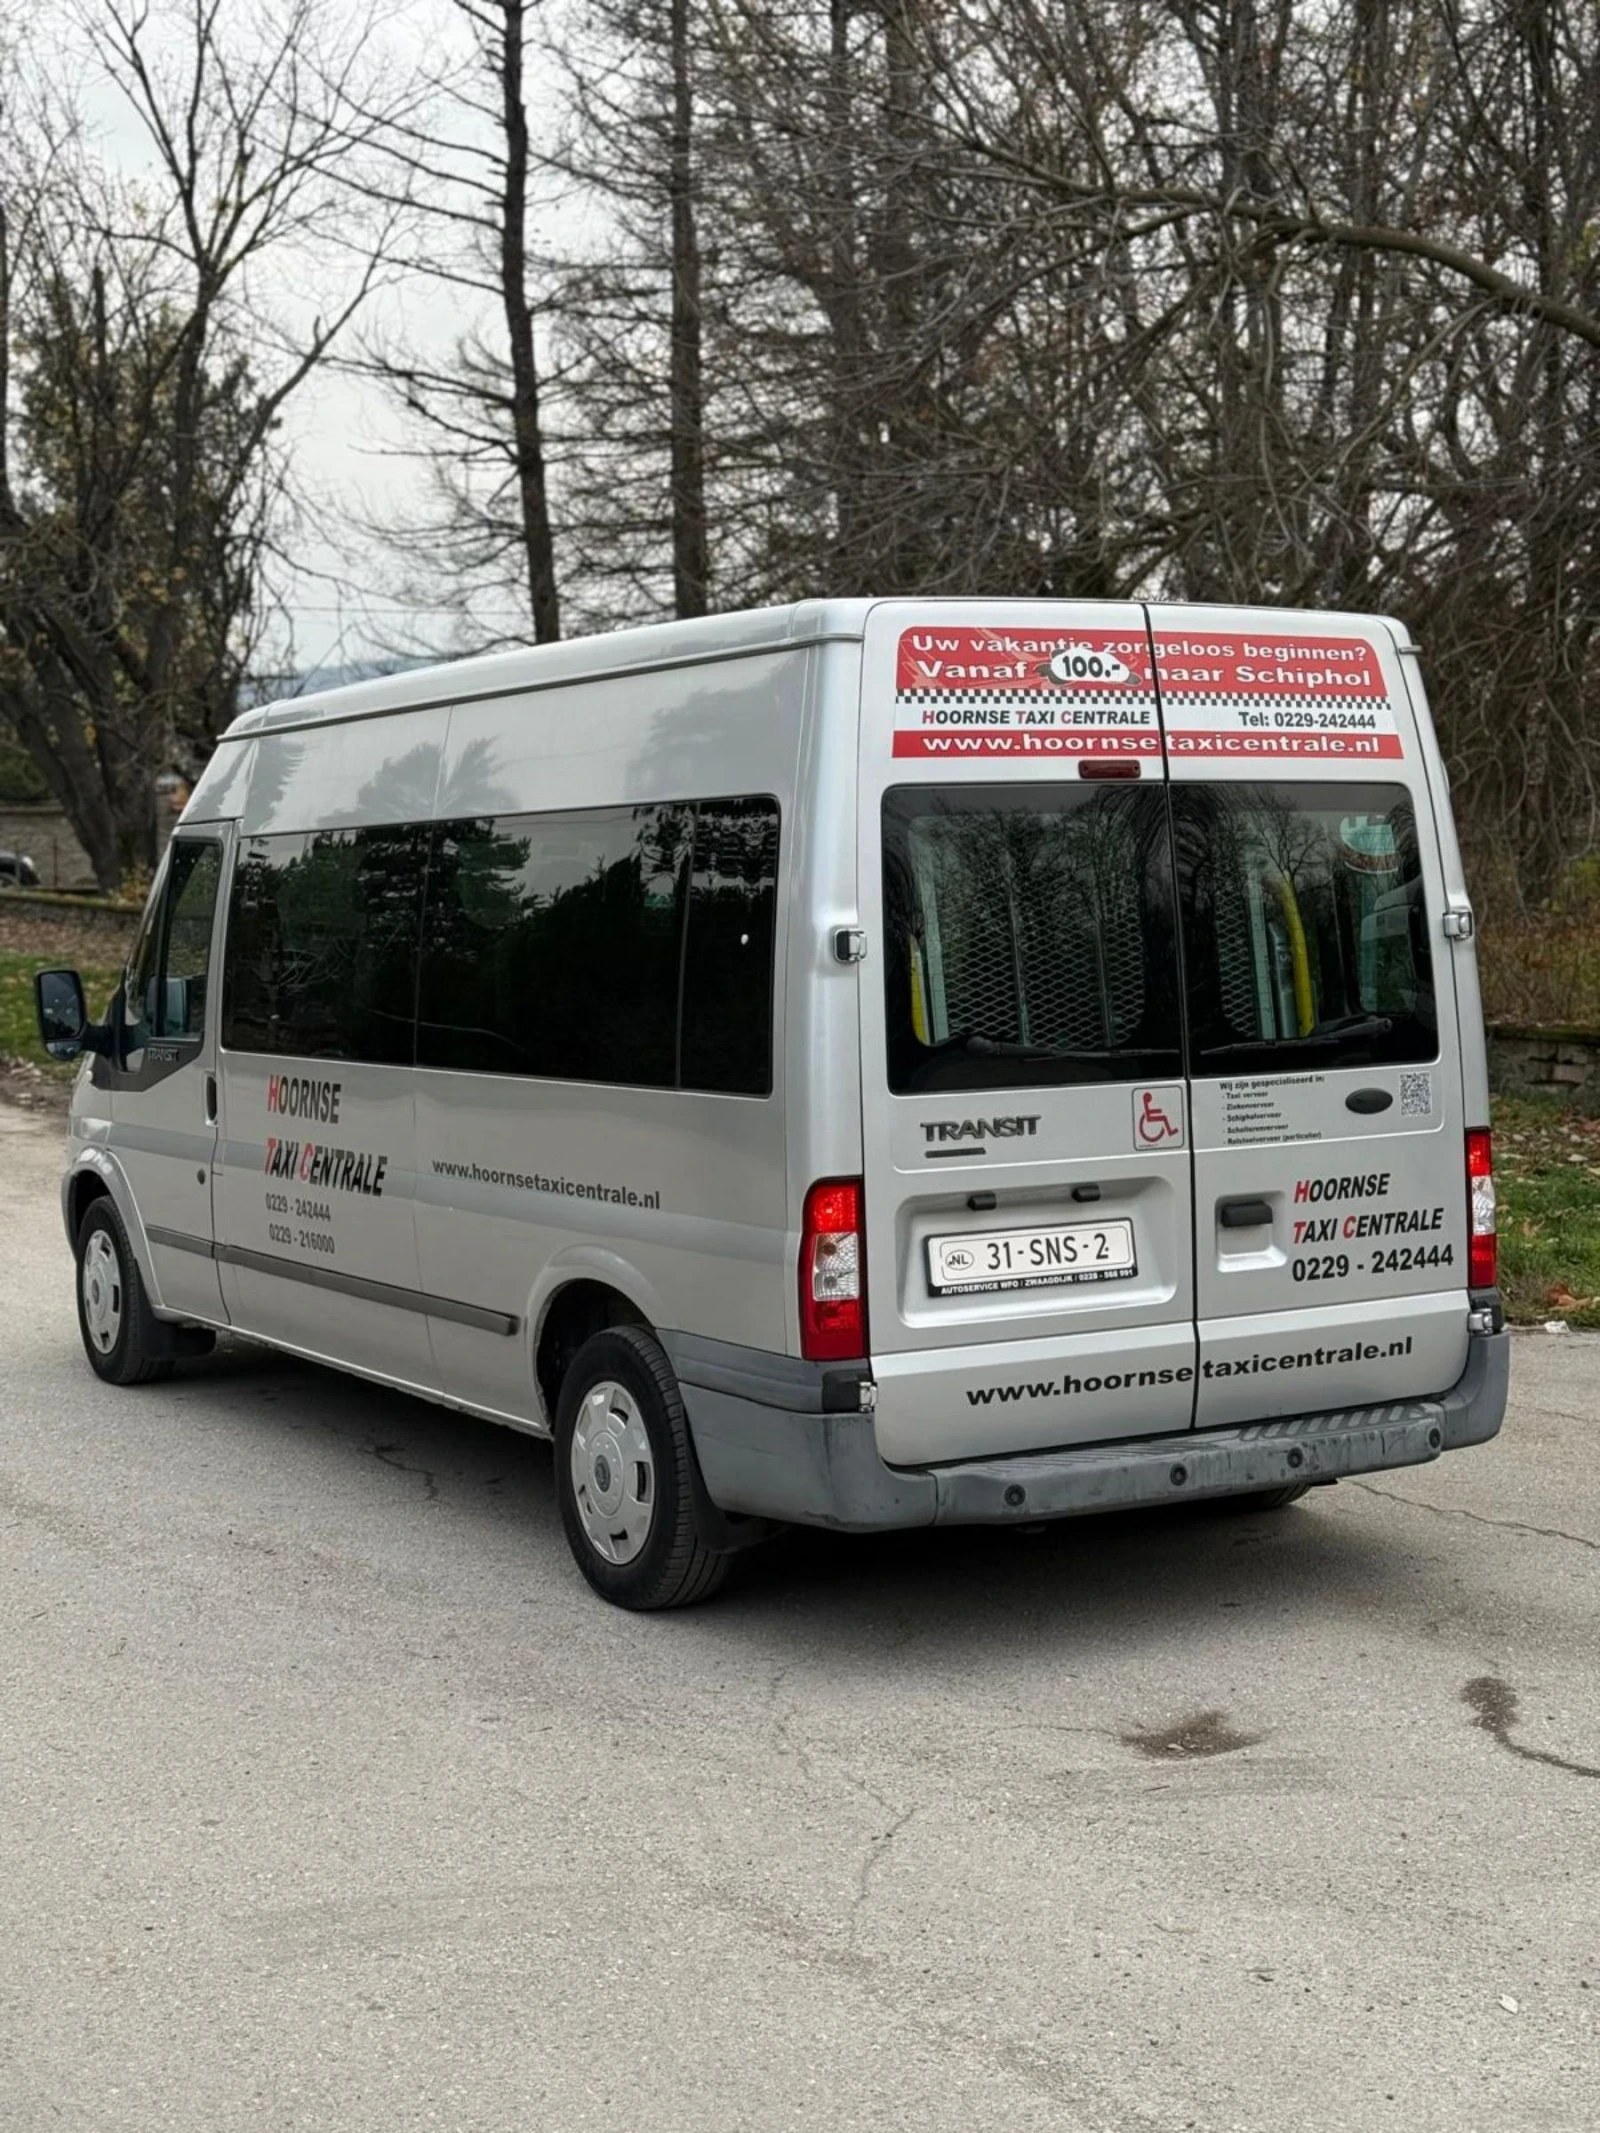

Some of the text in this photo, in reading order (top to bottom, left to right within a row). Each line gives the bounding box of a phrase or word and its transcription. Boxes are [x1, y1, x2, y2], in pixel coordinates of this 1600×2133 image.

[911, 634, 1367, 662] Uw vakantie zorgeloos beginnen?
[917, 655, 1371, 689] Vanaf 100.- naar Schiphol
[922, 709, 1377, 729] HOORNSE TAXI CENTRALE Tel: 0229-242444
[267, 1074, 342, 1124] HOORNSE
[1220, 1081, 1233, 1091] Wij
[1236, 1080, 1249, 1090] zijn
[1251, 1076, 1313, 1089] gespecialiseerd
[920, 1114, 1042, 1142] TRANSIT
[264, 1137, 388, 1197] TAXI CENTRALE
[432, 1159, 661, 1210] www.hoornsetaxicentrale.nl
[1293, 1172, 1391, 1204] HOORNSE
[265, 1192, 289, 1214] 0229
[295, 1198, 332, 1223] 242444
[269, 1222, 292, 1245] 0229
[1293, 1207, 1444, 1244] TAXI CENTRALE
[1292, 1254, 1350, 1282] 0229
[1371, 1243, 1454, 1275] 242444
[940, 1281, 999, 1296] AUTOSERVICE
